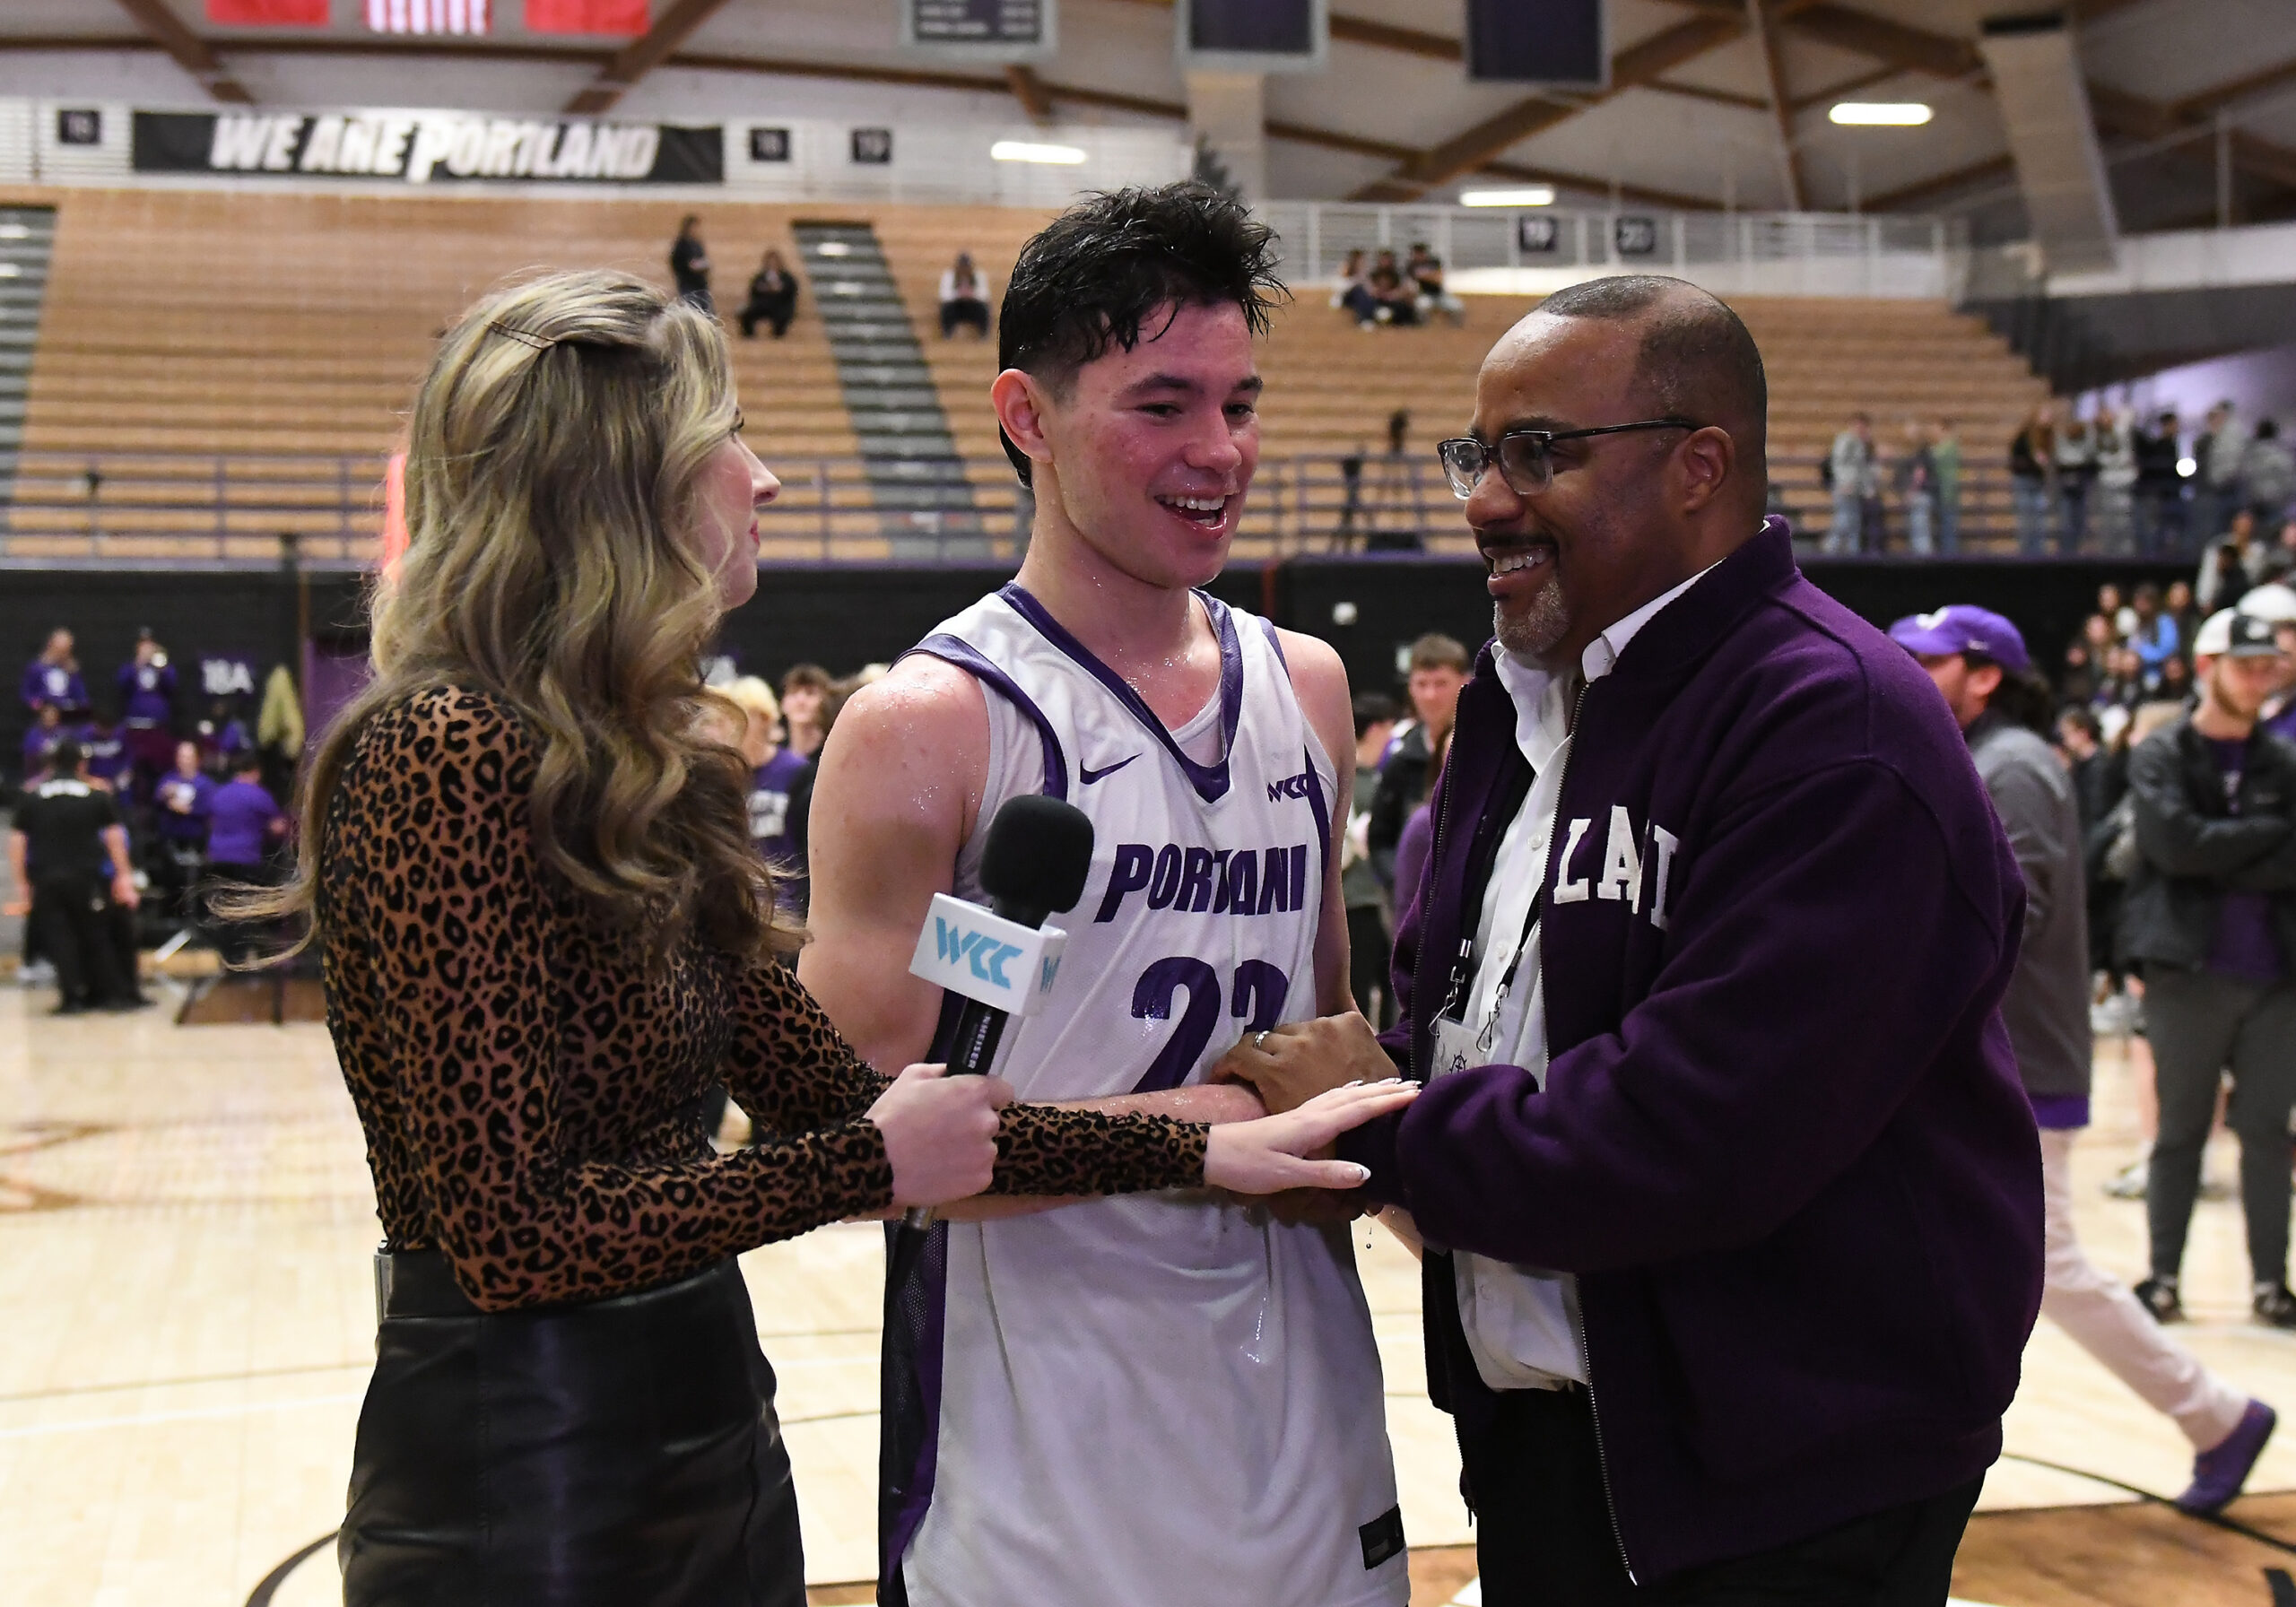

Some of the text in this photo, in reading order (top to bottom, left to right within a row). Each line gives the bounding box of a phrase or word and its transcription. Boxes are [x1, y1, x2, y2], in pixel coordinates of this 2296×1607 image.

[210, 116, 661, 184] WE ARE PORTLAND
[935, 916, 1024, 990] WCC
